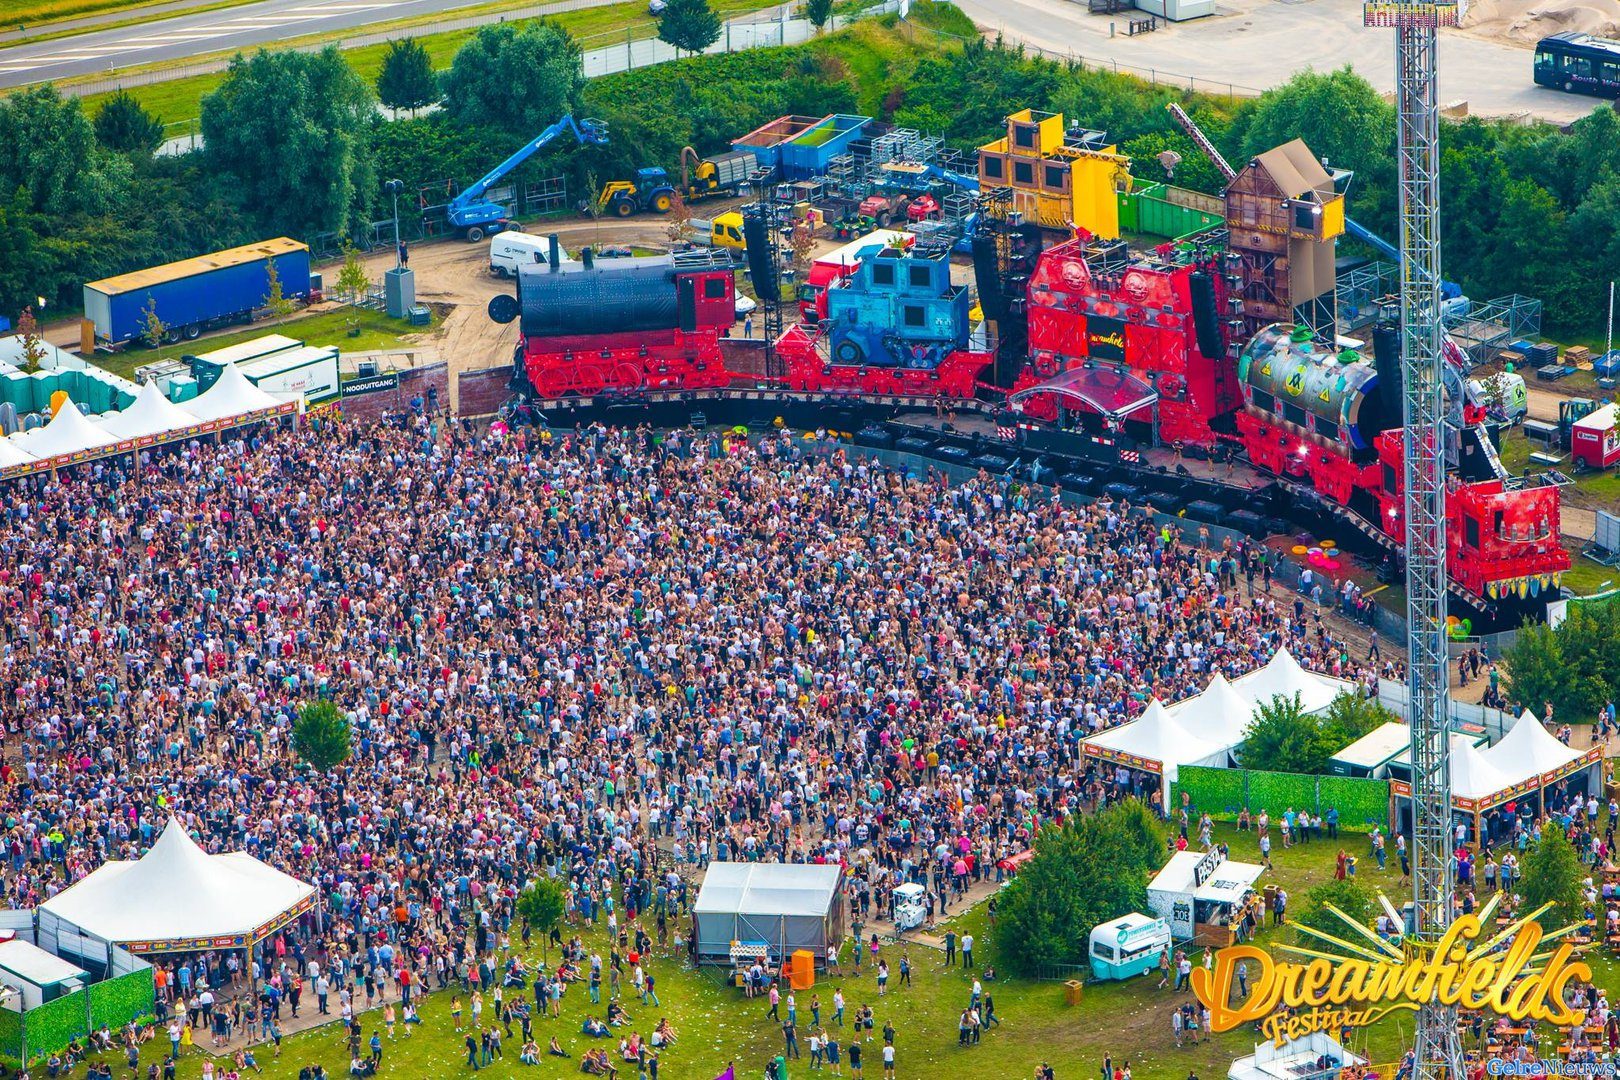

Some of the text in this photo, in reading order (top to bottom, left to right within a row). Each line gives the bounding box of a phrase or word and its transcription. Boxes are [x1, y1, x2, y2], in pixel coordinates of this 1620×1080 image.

[1571, 73, 1599, 84] South
[345, 378, 394, 393] NOODUITGANG
[1198, 848, 1221, 885] PASTA
[1174, 909, 1190, 922] JOE
